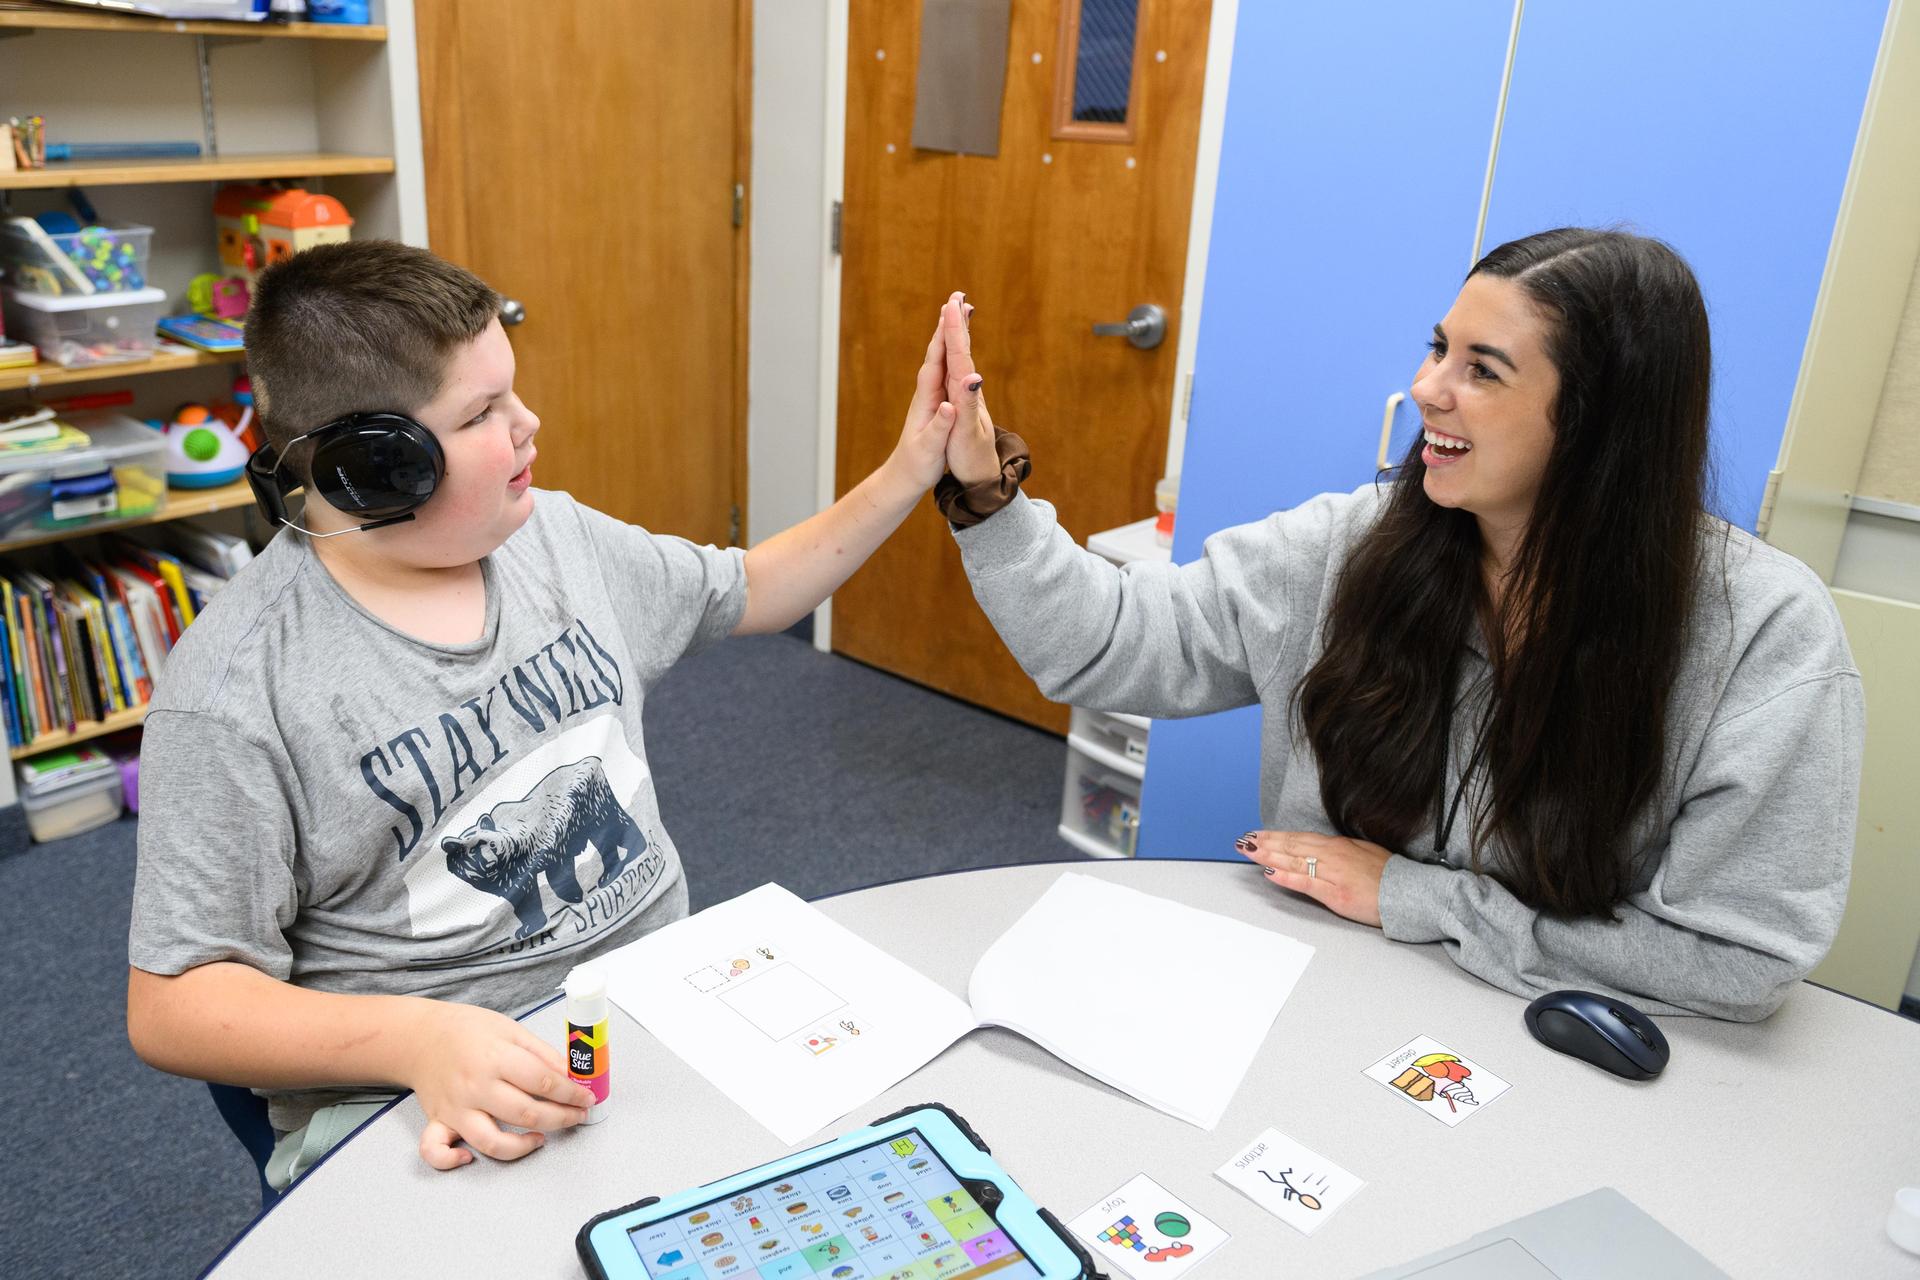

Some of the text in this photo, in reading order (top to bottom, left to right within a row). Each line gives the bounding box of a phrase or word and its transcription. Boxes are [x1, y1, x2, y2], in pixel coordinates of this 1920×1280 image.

[360, 686, 509, 862] STAY
[570, 1048, 592, 1061] Glue
[571, 1058, 591, 1070] Stic
[896, 1140, 910, 1151] H
[1235, 1142, 1268, 1169] actions
[876, 1181, 892, 1190] soup
[777, 1190, 801, 1201] chicken
[734, 1204, 761, 1218] nuggets
[887, 1199, 914, 1213] sandwich
[1101, 1197, 1126, 1214] toys
[787, 1208, 821, 1225] hamburger
[853, 1213, 875, 1226] grilled
[687, 1219, 722, 1235] chick sand
[753, 1228, 769, 1236] fries
[910, 1221, 926, 1231] jelly
[649, 1231, 667, 1241] clear
[806, 1231, 830, 1243] cheese
[702, 1241, 733, 1257] fish sand
[759, 1246, 791, 1262] spaghetti
[721, 1265, 740, 1276] pizza
[778, 1264, 793, 1275] and
